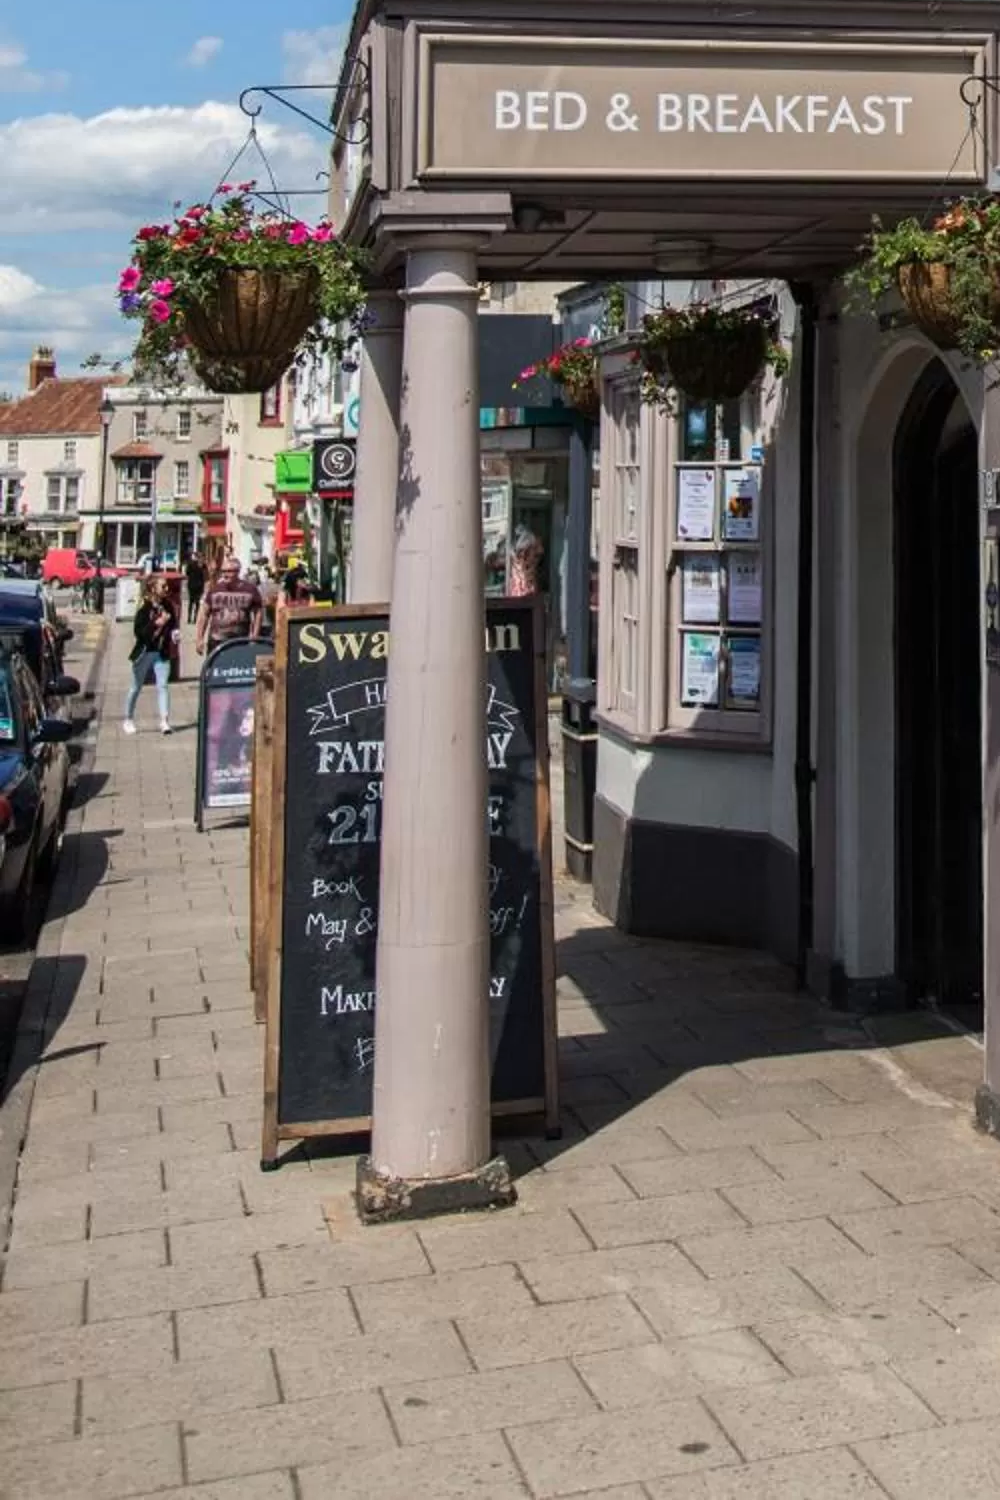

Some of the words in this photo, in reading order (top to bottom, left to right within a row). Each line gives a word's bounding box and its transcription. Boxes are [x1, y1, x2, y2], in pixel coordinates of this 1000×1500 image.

[494, 90, 588, 132] BED
[605, 92, 640, 133] &
[657, 93, 913, 136] BREAKFAST
[298, 623, 389, 664] Swa
[311, 875, 366, 902] Book
[305, 911, 347, 951] May
[354, 907, 376, 935] &
